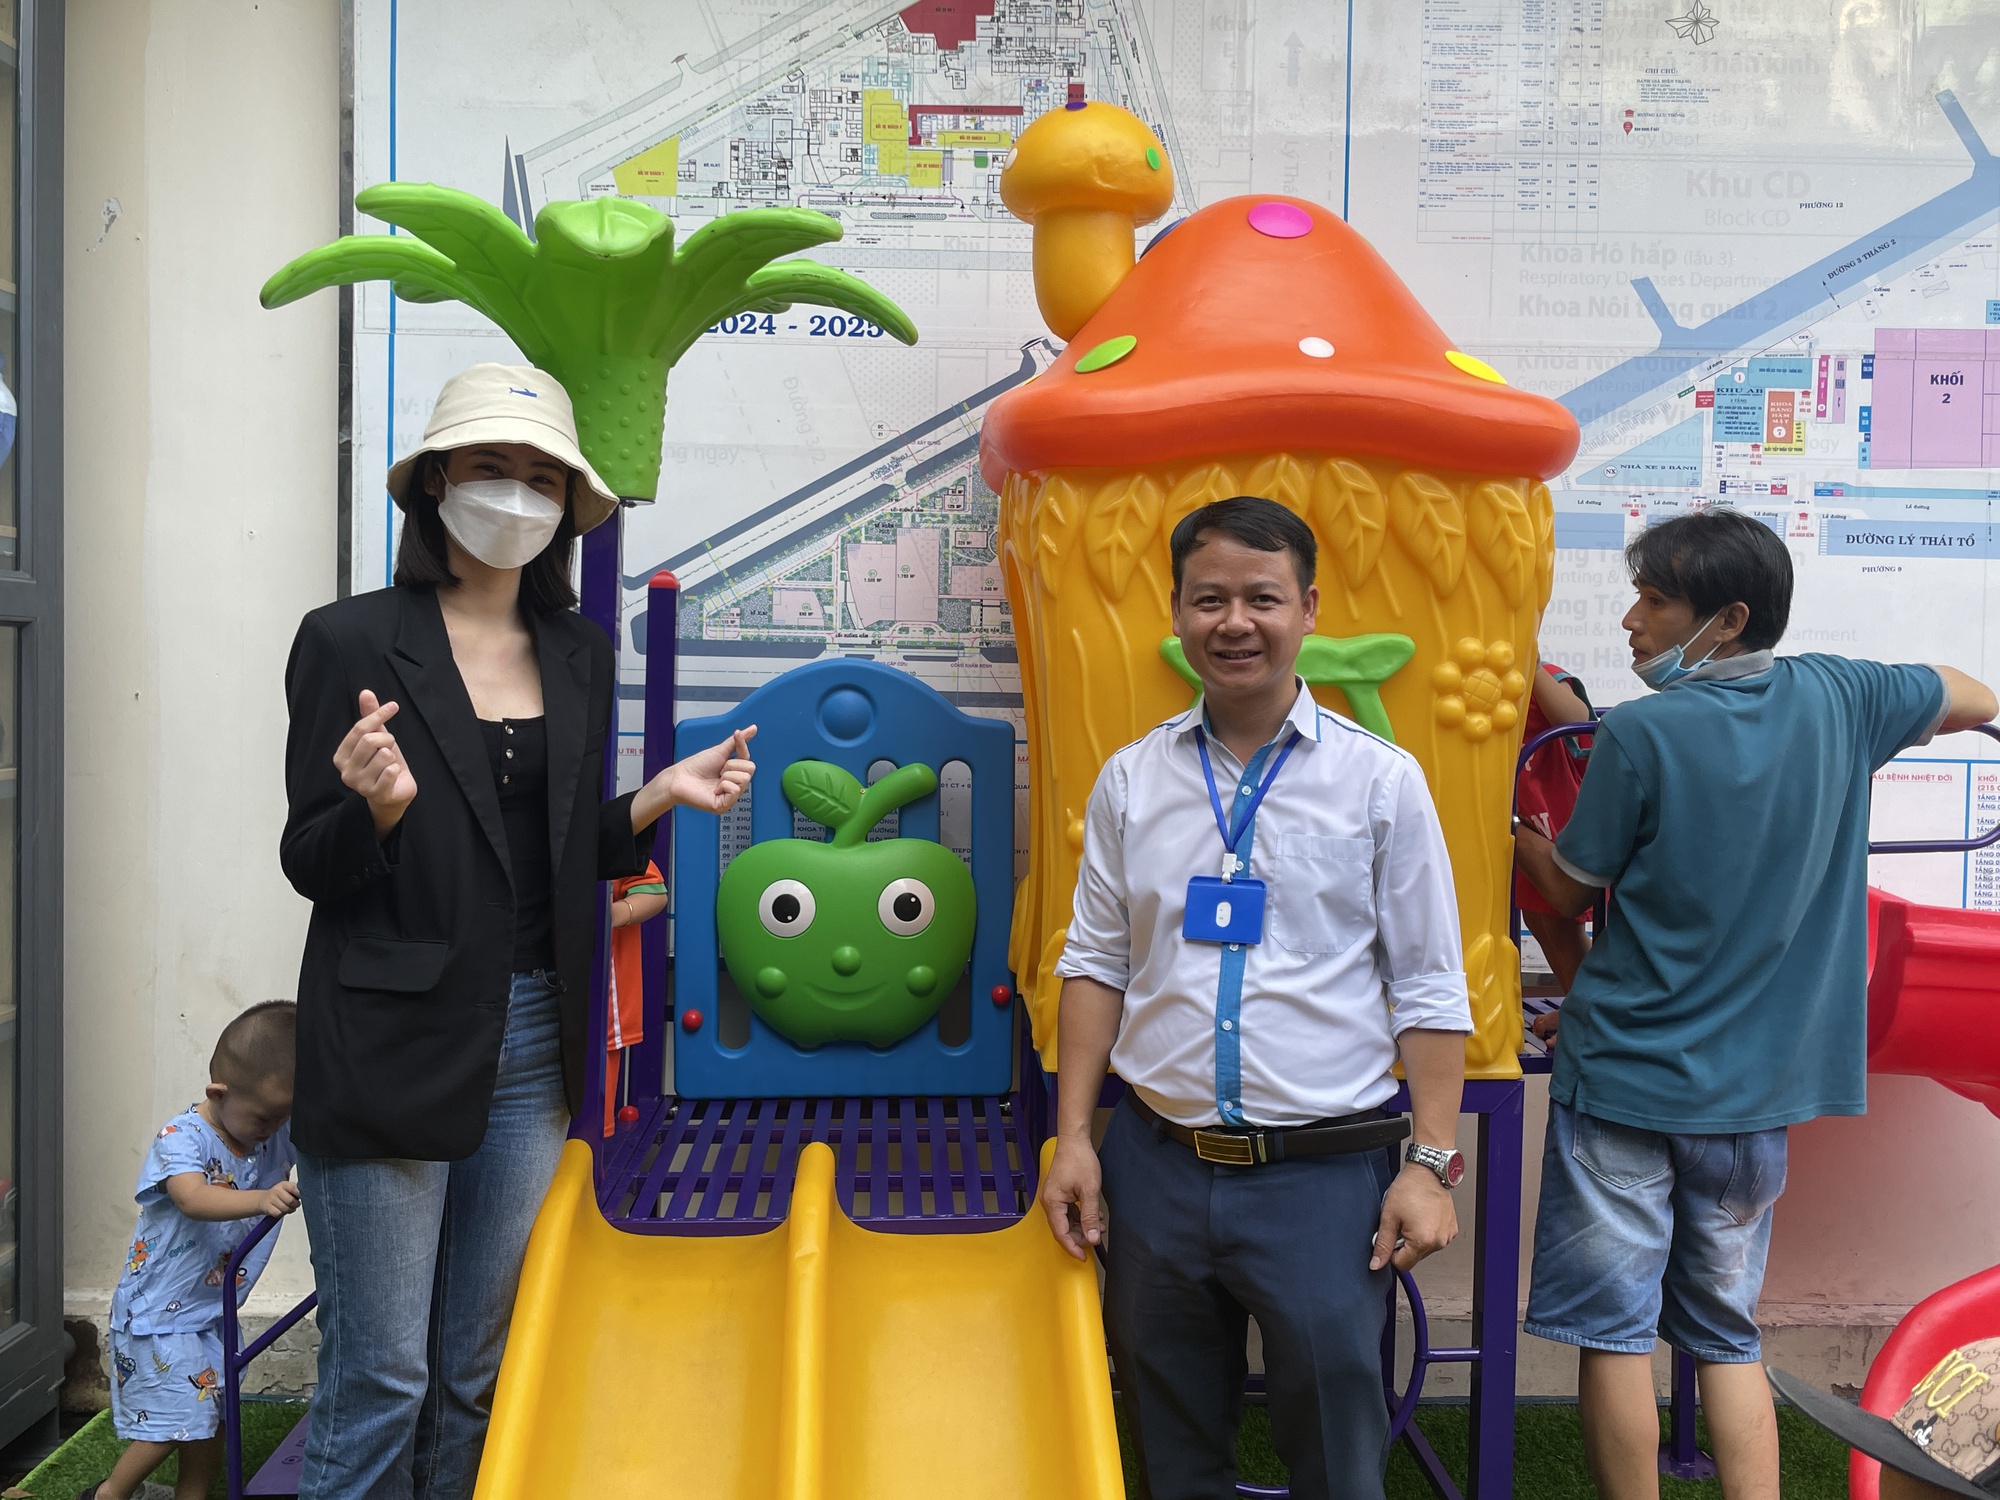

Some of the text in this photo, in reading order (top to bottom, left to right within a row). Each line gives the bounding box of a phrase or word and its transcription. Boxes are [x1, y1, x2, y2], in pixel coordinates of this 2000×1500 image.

[1686, 168, 1811, 199] Khu CD
[1704, 208, 1790, 228] Block CD
[1520, 240, 1582, 264] Khoa
[1862, 243, 1890, 261] THÁNG
[1519, 270, 1611, 288] Respiratory
[1518, 293, 1581, 317] Khoa
[809, 315, 884, 338] 2025
[1930, 371, 1964, 386] KHỐI
[1941, 393, 1951, 404] 2
[1669, 463, 1697, 471] BÁNH
[1846, 532, 1976, 547] ĐƯỜNG LÝ THÁI TỔ
[1541, 645, 1586, 674] òng
[1887, 773, 1909, 781] BỆNH
[1912, 774, 1935, 782] NHIỆT
[1937, 773, 1953, 781] ĐỚI
